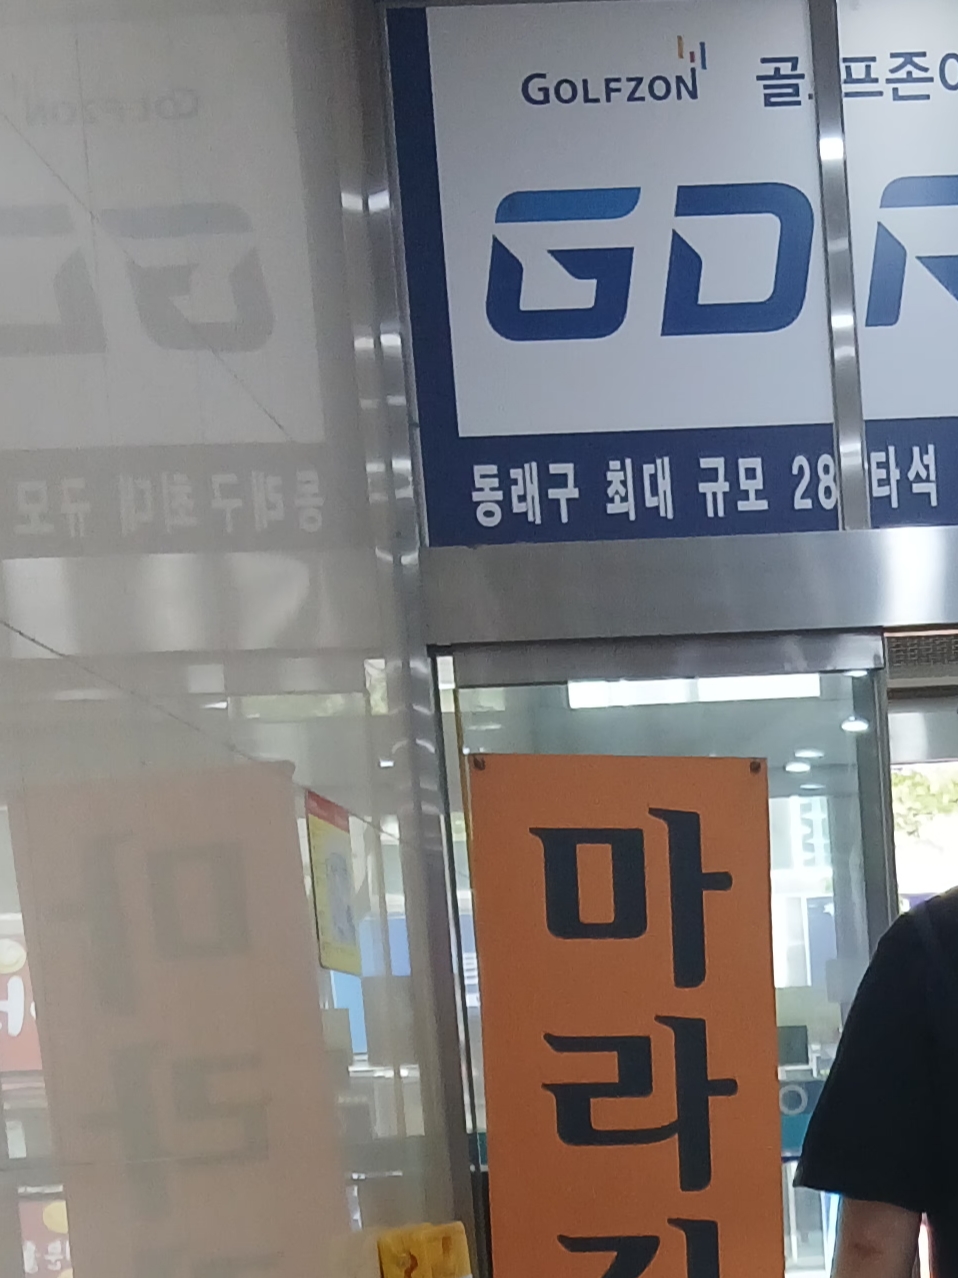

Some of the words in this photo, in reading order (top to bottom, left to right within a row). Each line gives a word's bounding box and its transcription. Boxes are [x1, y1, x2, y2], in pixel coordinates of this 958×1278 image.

[522, 67, 699, 105] GOLFZON
[471, 464, 580, 528] 동래구
[605, 456, 674, 521] 최대
[698, 455, 769, 512] 규모
